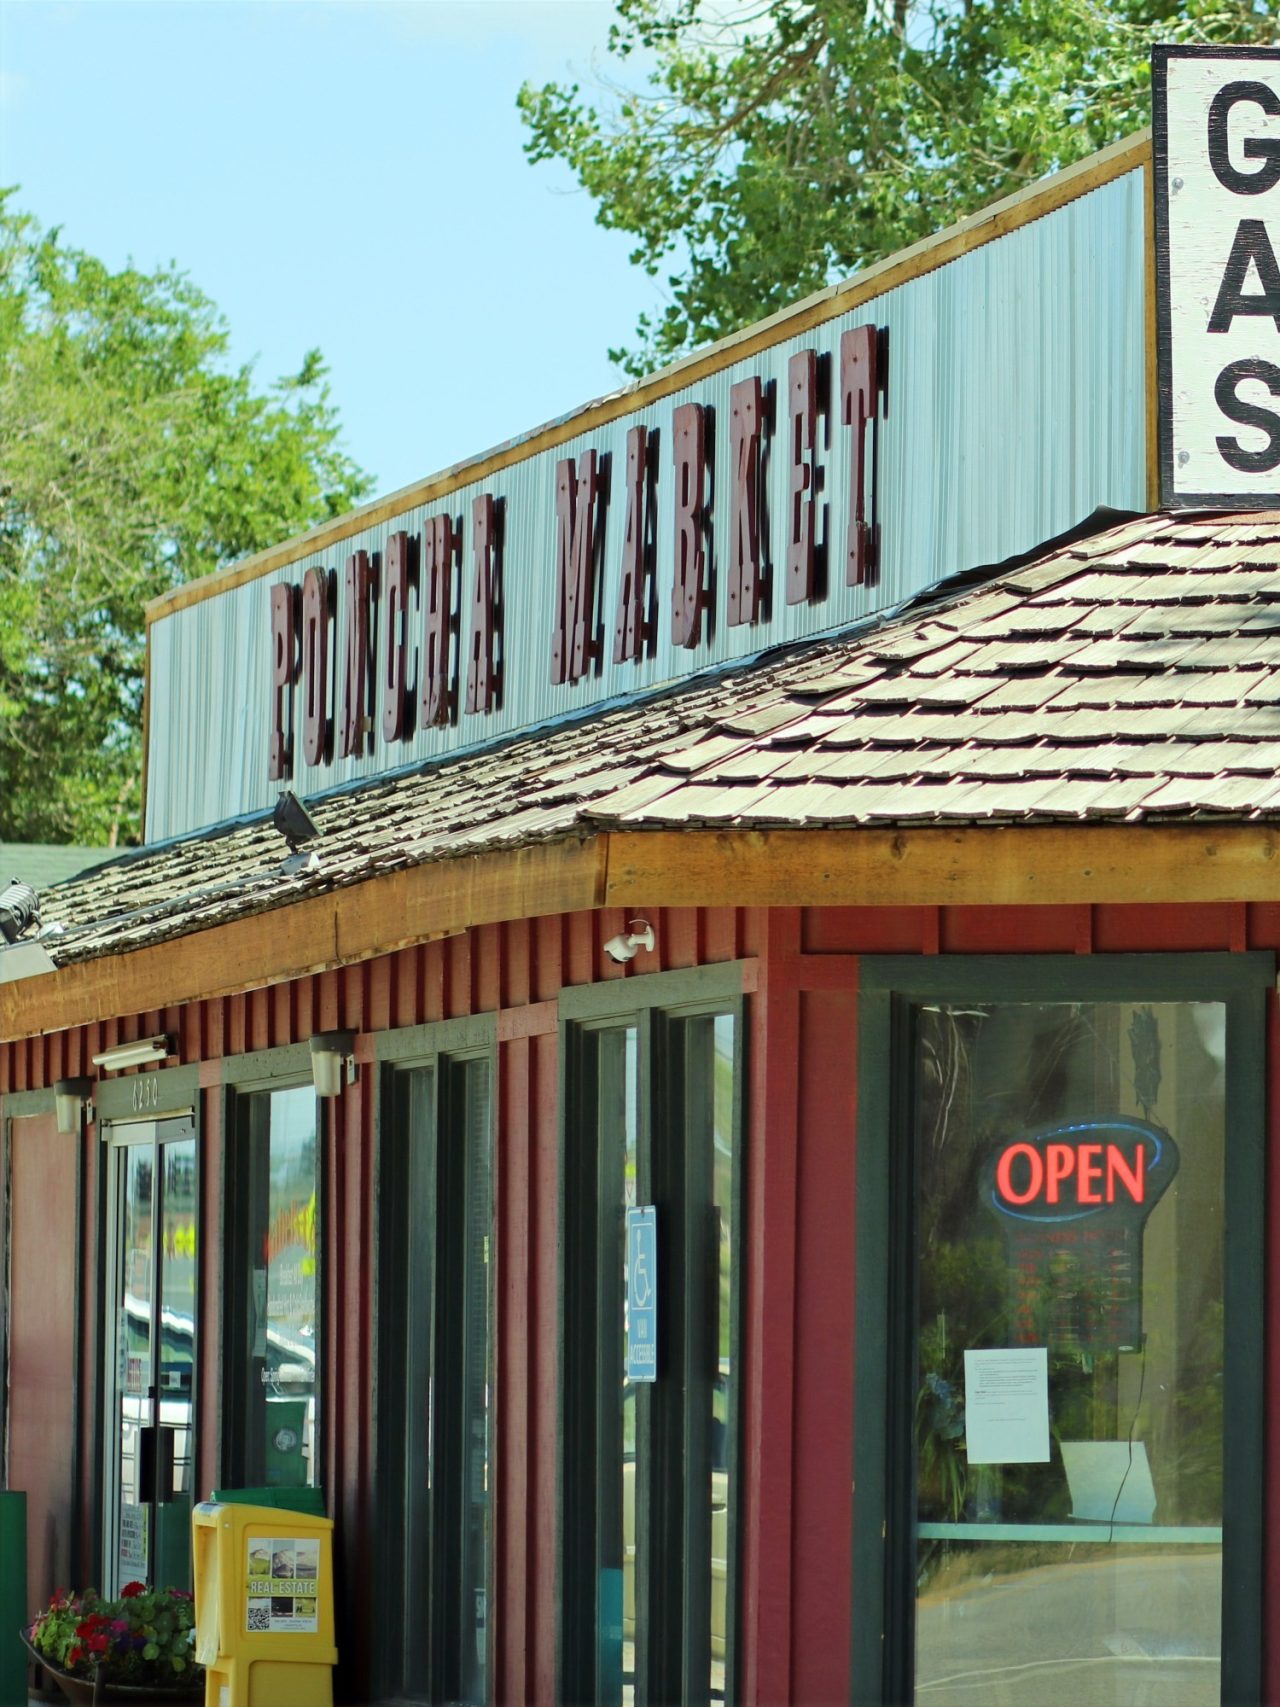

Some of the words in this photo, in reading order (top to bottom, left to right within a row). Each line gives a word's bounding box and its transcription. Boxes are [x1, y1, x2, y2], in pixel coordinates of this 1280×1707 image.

[269, 492, 495, 781] PONCHA
[549, 323, 880, 686] MARKET
[132, 1076, 158, 1112] 6250
[996, 1142, 1146, 1206] OPEN
[251, 1581, 274, 1593] REAL
[279, 1581, 315, 1594] ESTATE
